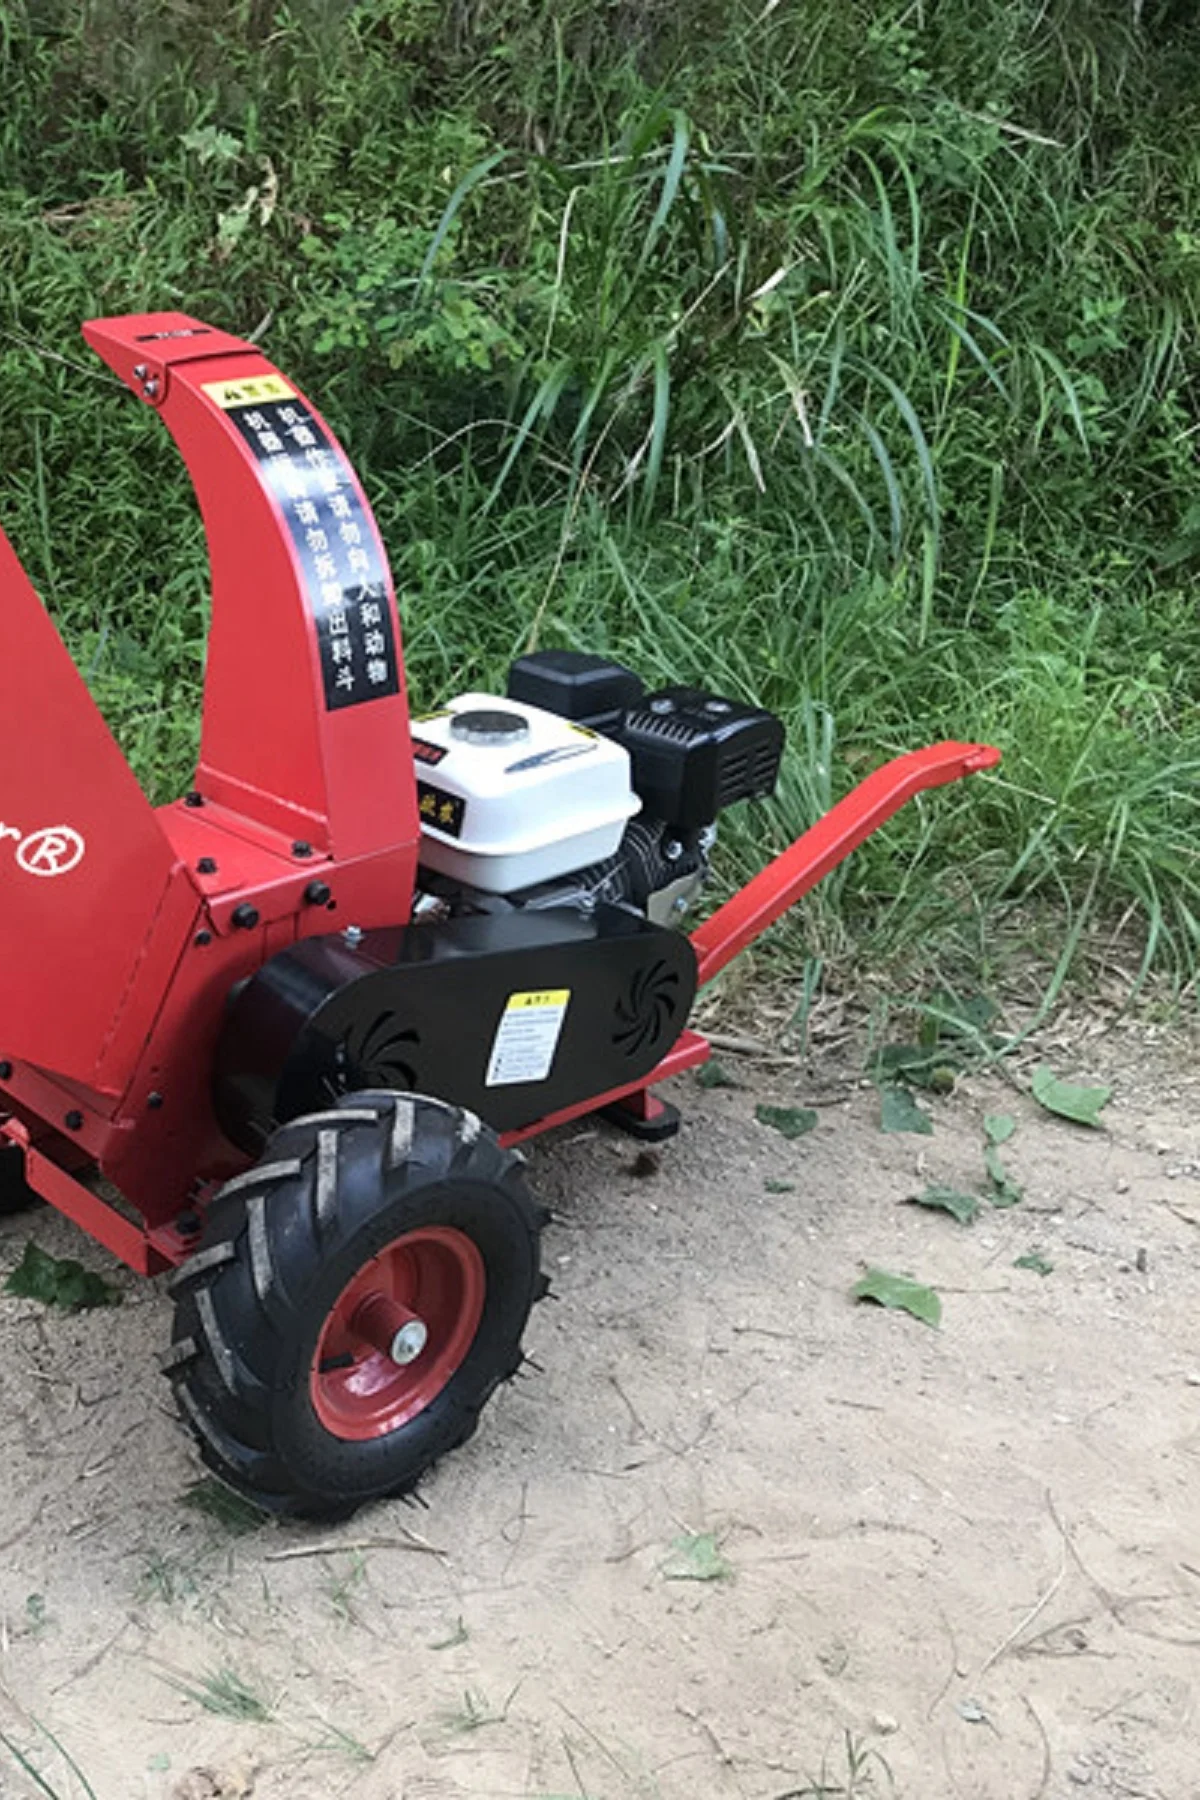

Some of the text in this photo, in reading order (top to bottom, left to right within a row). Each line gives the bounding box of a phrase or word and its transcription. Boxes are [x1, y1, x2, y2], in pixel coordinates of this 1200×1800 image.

[243, 411, 357, 691] 机器请勿拆出料斗
